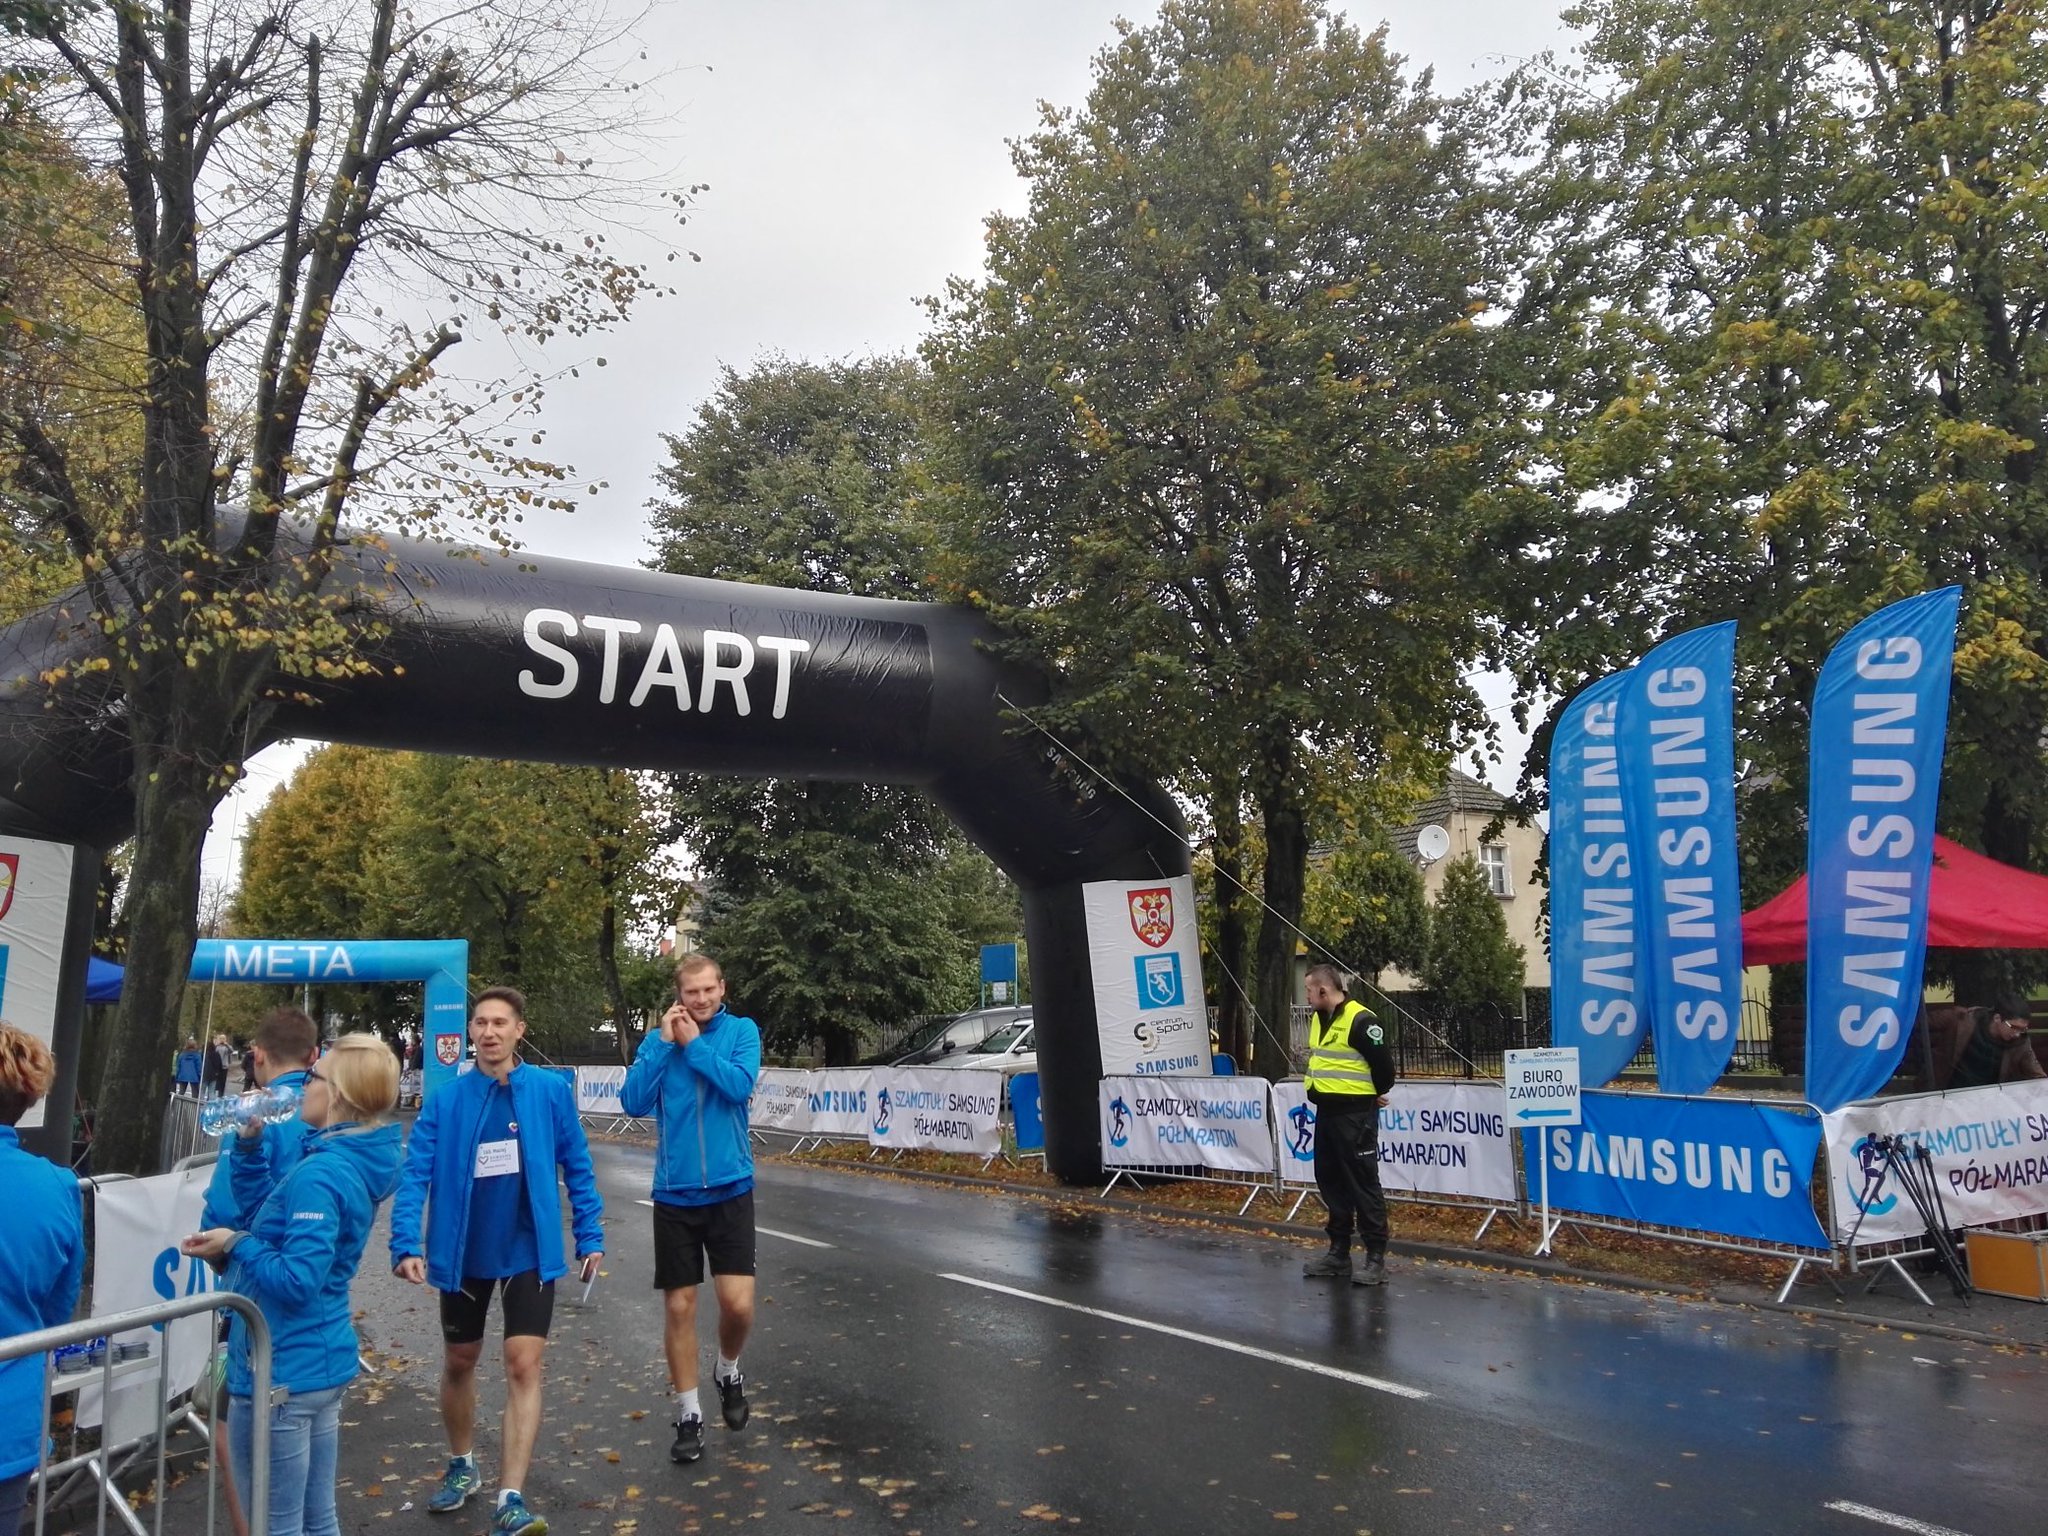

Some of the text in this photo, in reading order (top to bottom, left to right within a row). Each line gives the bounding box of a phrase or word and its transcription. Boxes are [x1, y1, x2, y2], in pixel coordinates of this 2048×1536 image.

[518, 608, 811, 720] START
[1647, 665, 1728, 1041] SAMSUNG
[1838, 636, 1923, 1050] SAMSUNG
[1581, 700, 1638, 1036] SAMSUNG
[223, 944, 355, 977] META
[1150, 1017, 1183, 1026] centrum
[1156, 1021, 1194, 1034] sportu
[1135, 1054, 1199, 1075] SAMSUNG
[1523, 1069, 1563, 1083] BIURO
[582, 1081, 621, 1098] SAMSUNG
[895, 1090, 996, 1116] SZAMOTUŁY SAMSUNG
[1509, 1081, 1577, 1099] ZAWODÓW
[1200, 1100, 1262, 1120] SAMSUNG
[1377, 1109, 1504, 1138] TUŁY SAMSUNG
[914, 1113, 975, 1142] PÓŁMARATON
[2025, 1113, 2048, 1142] SA
[1552, 1128, 1792, 1198] SAMSUNG
[1949, 1157, 2048, 1197] PÓŁMARA
